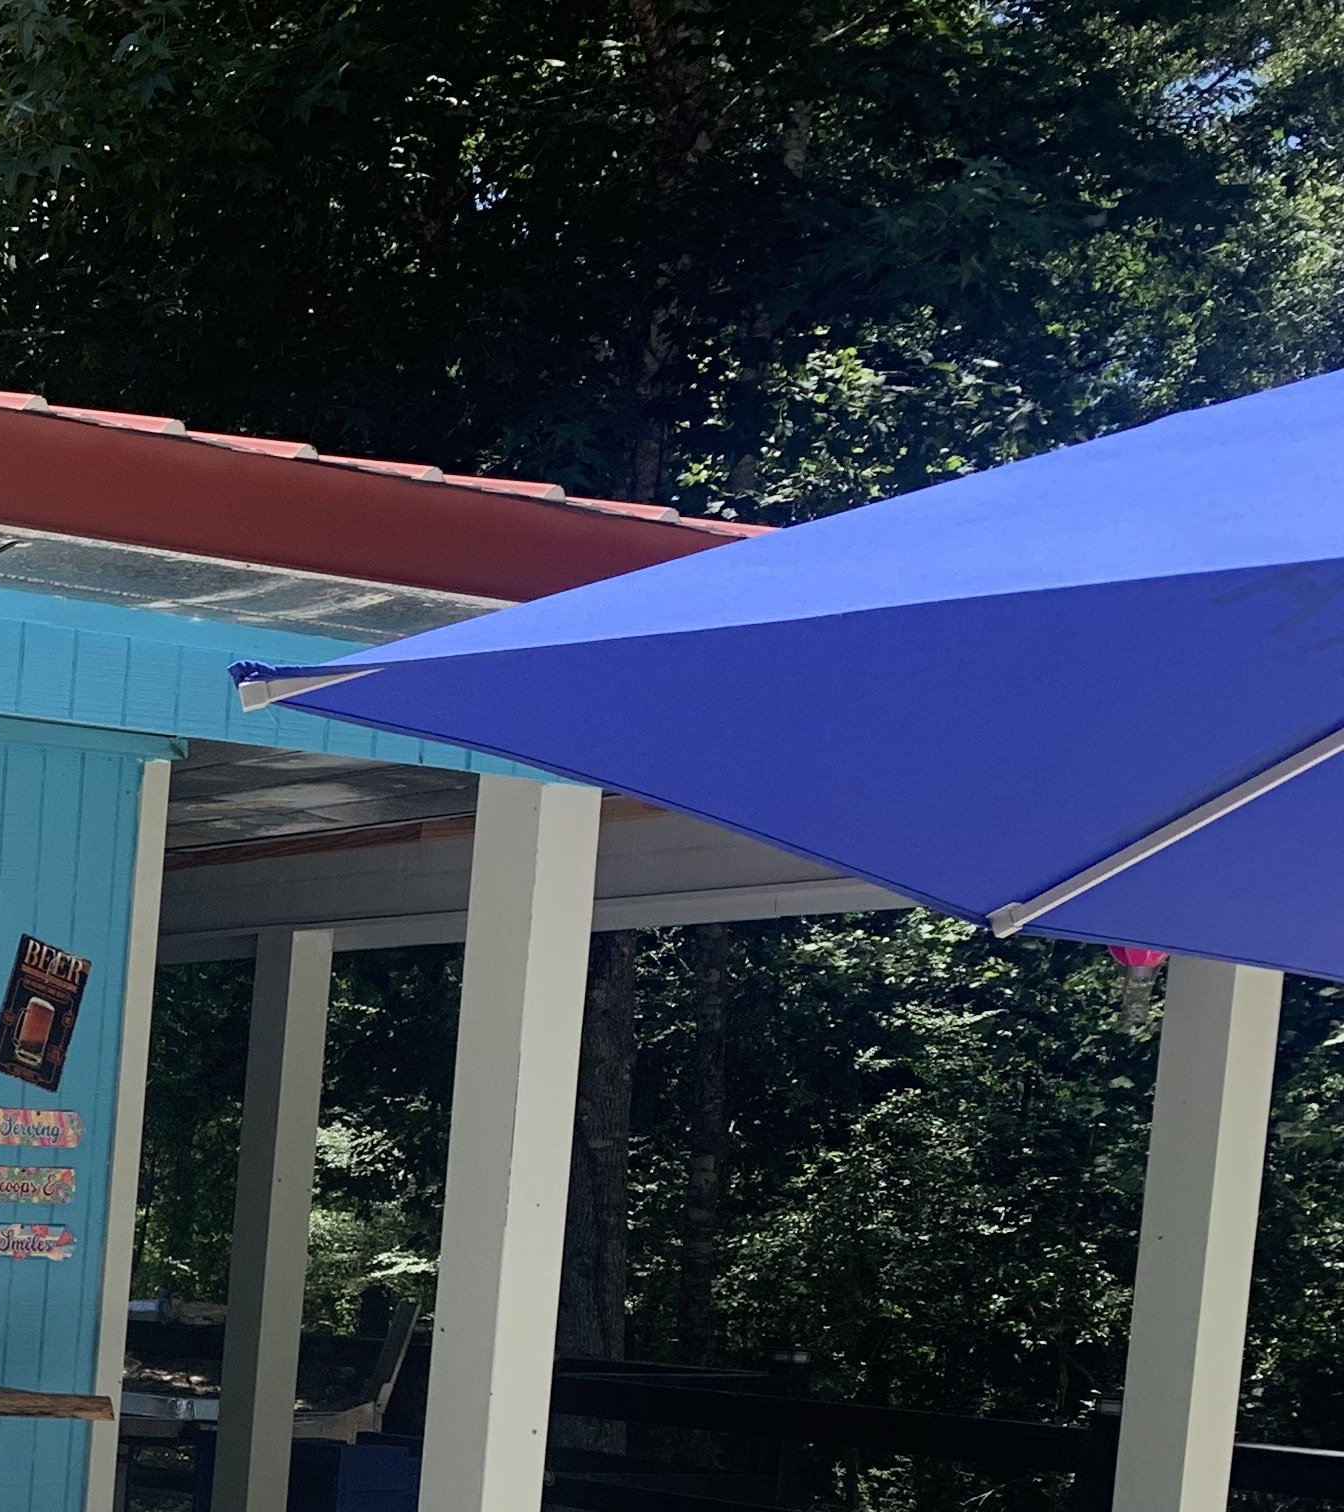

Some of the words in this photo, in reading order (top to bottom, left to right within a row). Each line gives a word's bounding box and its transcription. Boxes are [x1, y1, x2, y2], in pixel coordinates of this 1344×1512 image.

[23, 939, 83, 985] BEER
[0, 1113, 61, 1143] Serving
[43, 1173, 57, 1196] &
